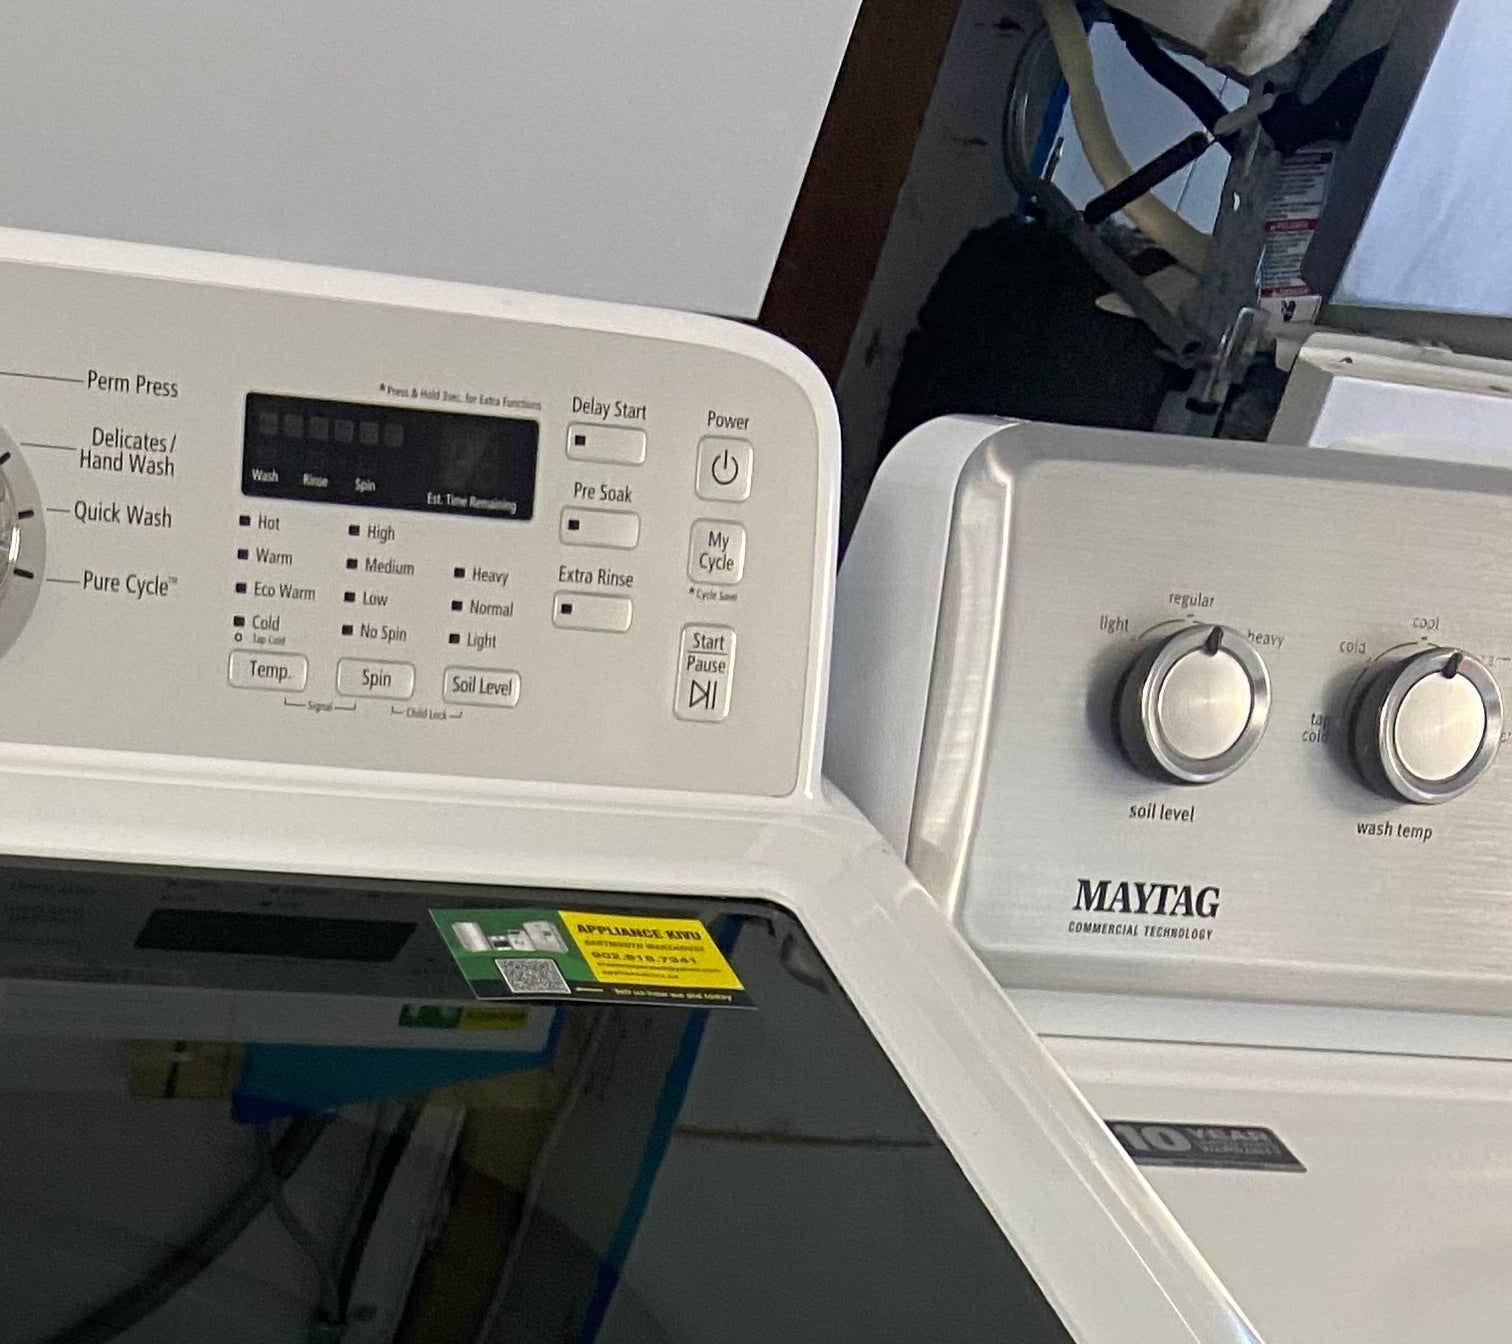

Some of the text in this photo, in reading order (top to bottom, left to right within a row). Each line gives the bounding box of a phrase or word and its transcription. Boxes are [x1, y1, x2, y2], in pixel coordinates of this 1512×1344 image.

[88, 369, 178, 398] Perm Press
[387, 385, 409, 397] Press
[420, 389, 440, 401] Hold
[465, 392, 477, 404] for
[480, 394, 500, 407] Extra
[503, 397, 541, 410] Functions
[572, 397, 647, 422] Delay Start
[708, 410, 750, 433] Power
[92, 427, 176, 454] Delicates/
[80, 449, 175, 477] Hand Wash
[252, 468, 279, 482] Wash
[303, 473, 328, 488] Rinse
[355, 478, 375, 493] Spin
[427, 492, 517, 515] Est. Time Remaining
[574, 482, 632, 504] Pre Soak
[74, 499, 172, 528] Quick Wash
[258, 514, 280, 532] Hot
[367, 522, 395, 544] High
[708, 531, 729, 553] My
[256, 547, 293, 567] Warm
[365, 557, 415, 577] Medium
[699, 552, 734, 574] Cycle
[84, 571, 120, 595] Pure
[472, 566, 509, 587] Heavy
[559, 565, 634, 588] Extra Rinse
[254, 580, 316, 603] Eco Warm
[362, 589, 388, 609] Low
[696, 589, 717, 601] Cycle
[1169, 592, 1215, 609] regular
[470, 599, 514, 618] Normal
[252, 613, 280, 632] Cold
[1100, 614, 1129, 634] light
[1412, 617, 1439, 631] cool
[360, 622, 408, 646] No Spin
[467, 631, 497, 651] Light
[693, 633, 725, 651] Start
[1248, 629, 1285, 649] heavy
[1339, 639, 1367, 655] cold
[686, 655, 727, 674] Pause
[362, 669, 392, 688] Spin
[452, 676, 513, 697] Soil Level
[307, 700, 332, 713] Signal
[406, 707, 447, 721] Child Lock
[1129, 802, 1195, 823] soil level
[1356, 820, 1433, 842] wash temp
[1072, 878, 1221, 919] MAYTAG
[577, 924, 663, 939] APPLIANCE
[1068, 920, 1214, 942] COMMERCIAL TECHNOLOGY
[1114, 1123, 1191, 1152] 10
